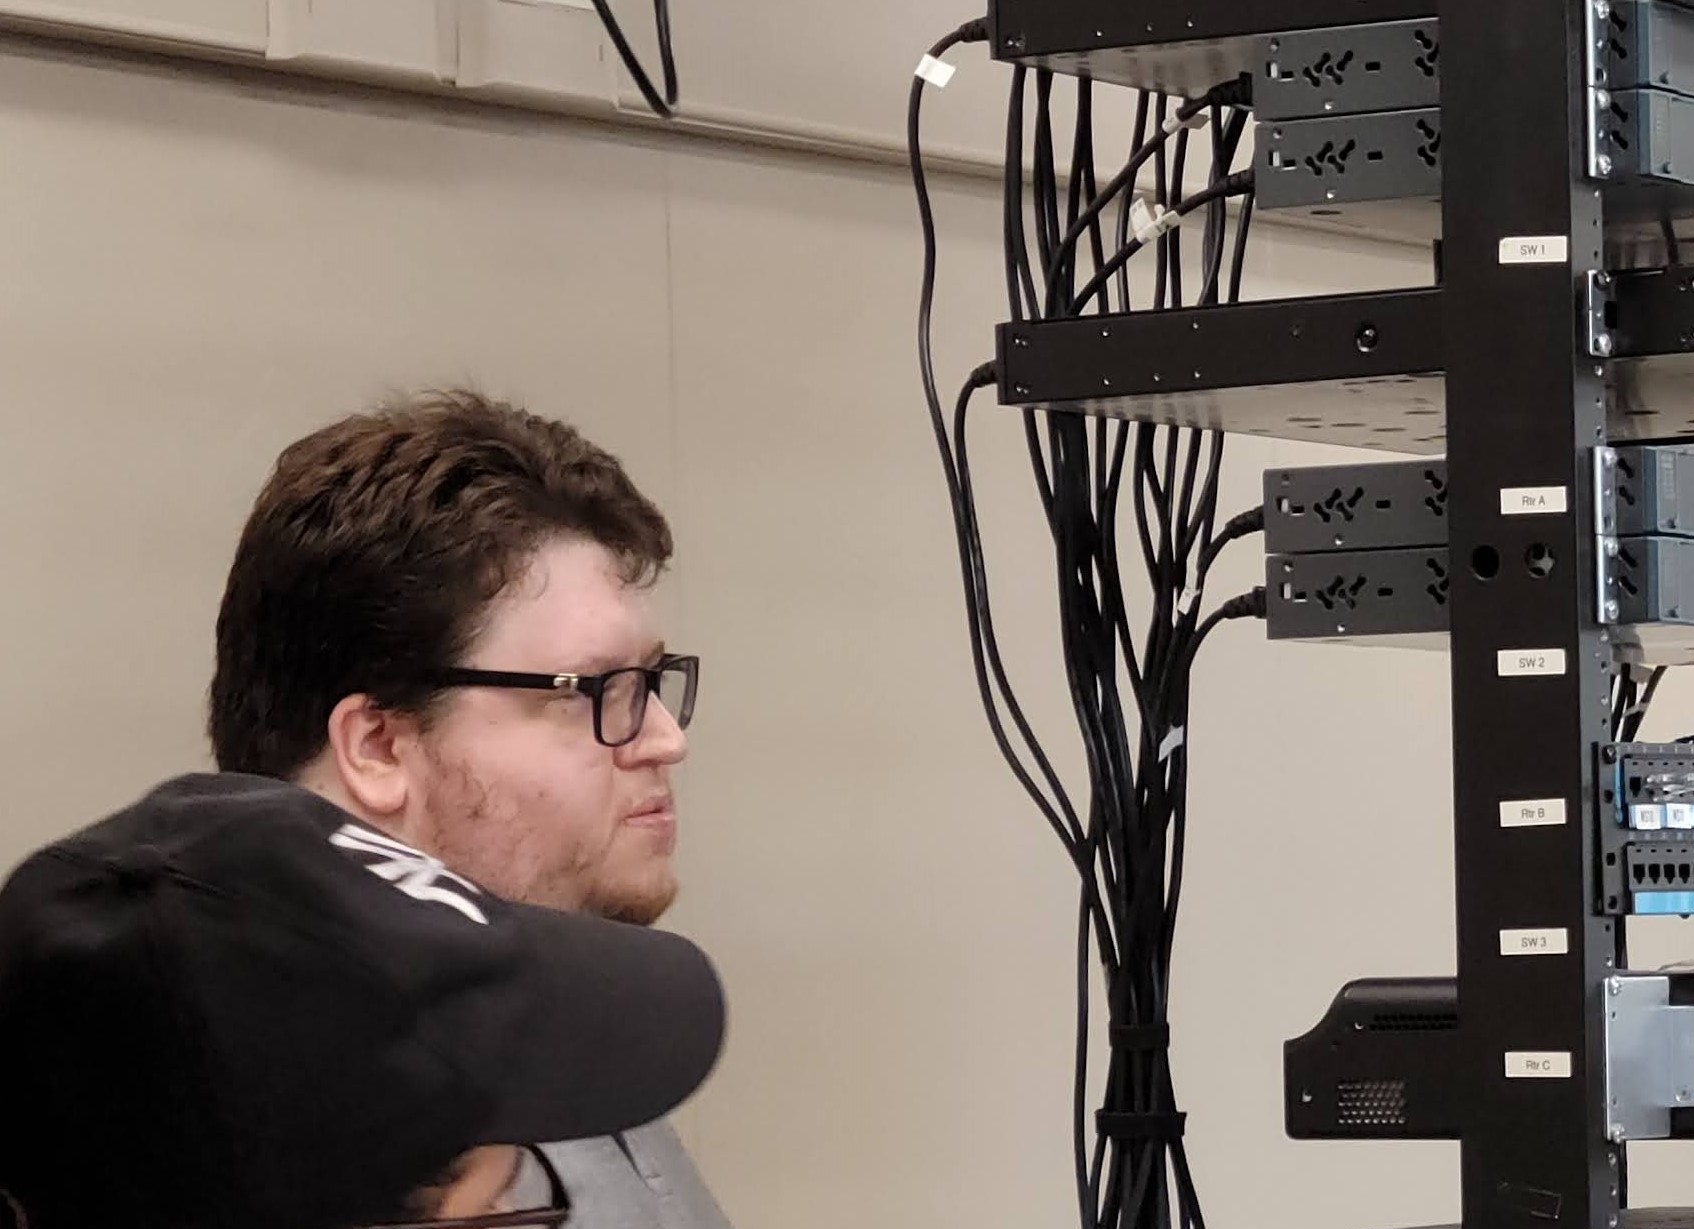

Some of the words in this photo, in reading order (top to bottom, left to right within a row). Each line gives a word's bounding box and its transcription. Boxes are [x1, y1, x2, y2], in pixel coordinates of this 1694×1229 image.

[1520, 245, 1538, 256] SW
[1521, 495, 1536, 506] Rtr
[1538, 494, 1546, 505] A
[1518, 657, 1536, 669] SW
[1537, 656, 1546, 668] 2
[1520, 808, 1535, 819] Rtr
[1536, 807, 1546, 818] B
[1520, 937, 1539, 949] SW
[1539, 937, 1547, 947] 3
[1525, 1060, 1540, 1071] Rtr
[1541, 1059, 1551, 1070] C
